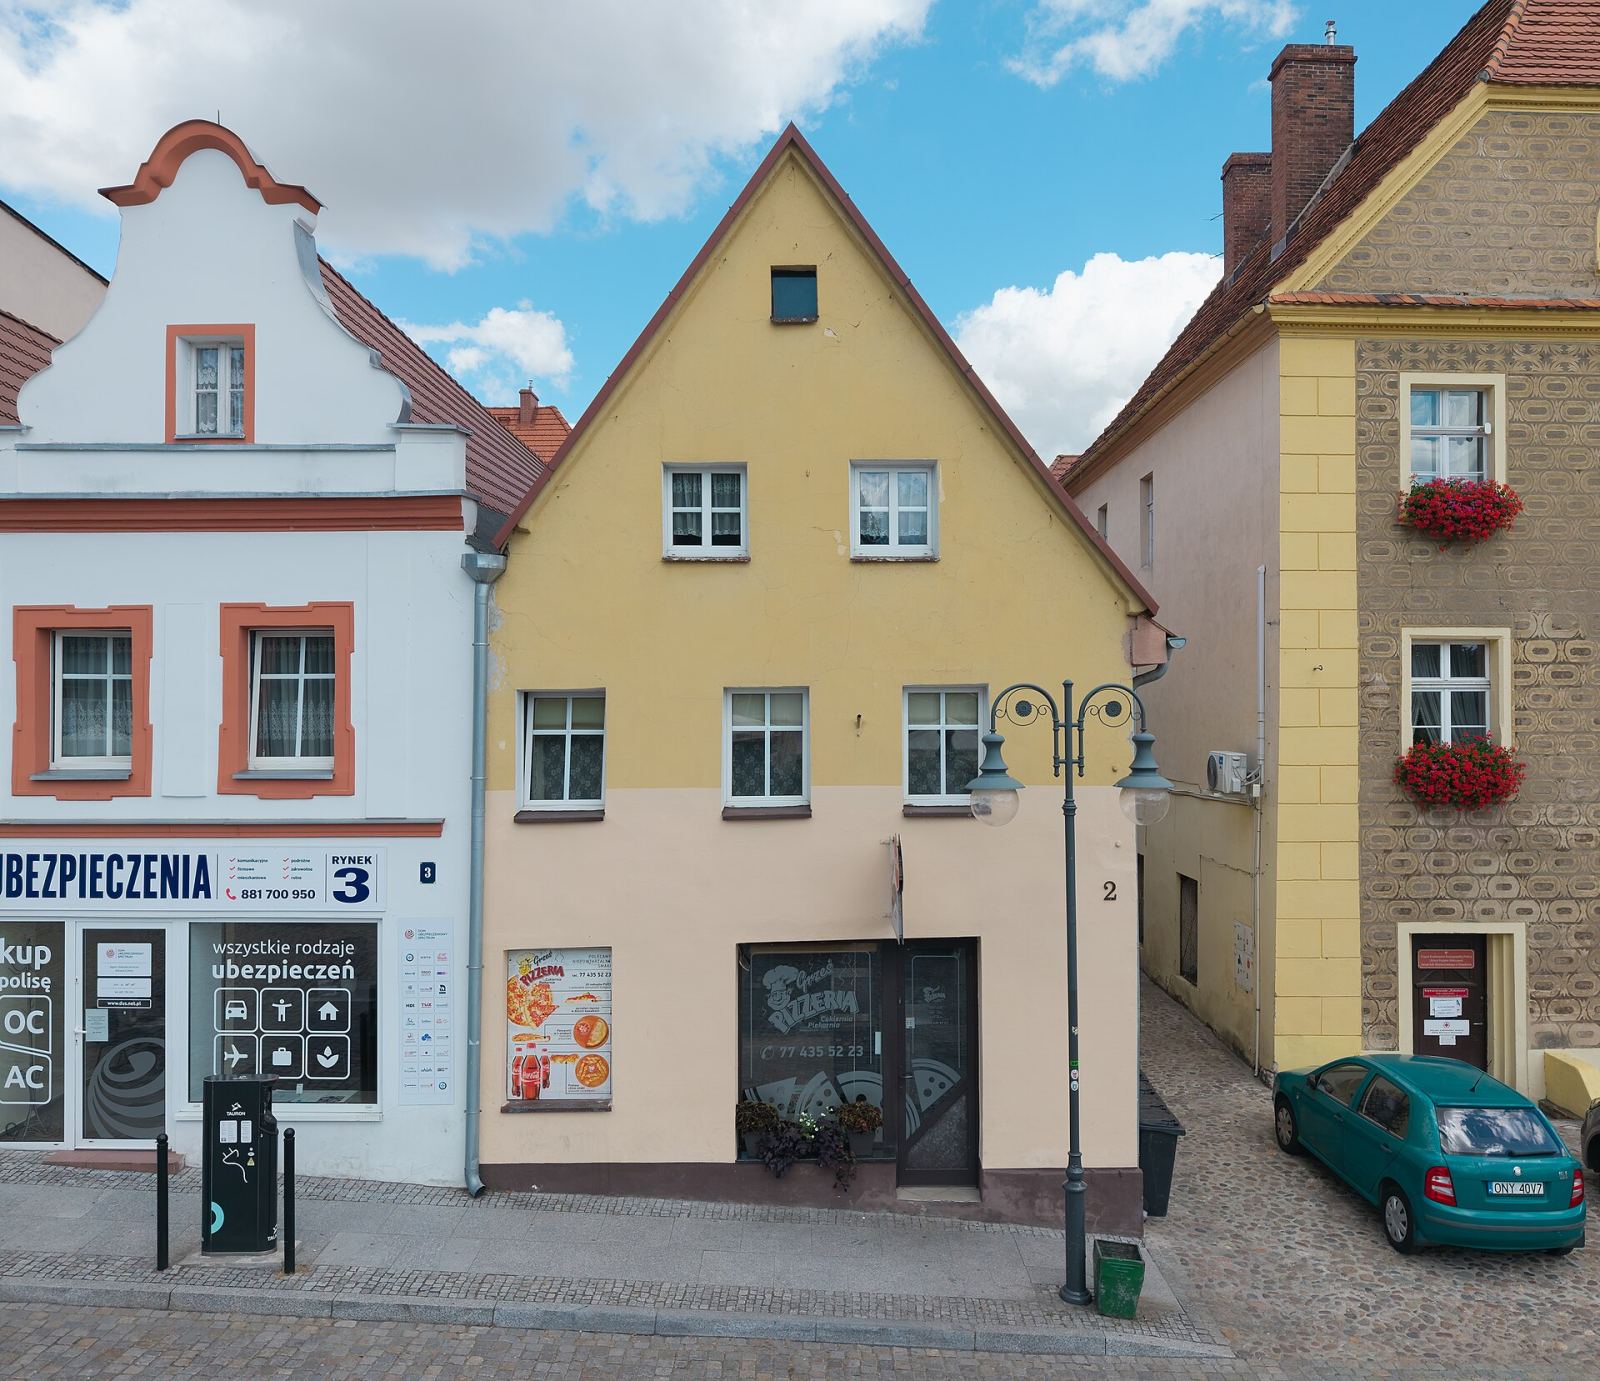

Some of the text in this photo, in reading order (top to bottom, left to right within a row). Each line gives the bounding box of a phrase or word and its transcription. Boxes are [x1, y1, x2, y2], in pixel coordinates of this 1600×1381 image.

[332, 855, 372, 865] RYNEK
[0, 853, 211, 899] BEZPIECZENIA
[424, 866, 432, 878] 3
[241, 889, 316, 899] 881 700 950
[332, 867, 370, 903] 3
[1103, 880, 1117, 901] 2
[0, 937, 52, 970] kup
[212, 939, 355, 957] wszystkie rodzaje
[212, 959, 355, 983] ubezpieczeń
[519, 965, 565, 986] PIZZERIA
[0, 971, 51, 993] polisę
[4, 1010, 44, 1034] OC
[768, 990, 860, 1035] PIZZERIA
[820, 1015, 853, 1023] Cukiernia
[807, 1021, 841, 1029] Piekarnia
[780, 1045, 864, 1058] 77 435 52 23
[4, 1065, 44, 1088] AC
[1494, 1183, 1542, 1194] ONY 40V7
